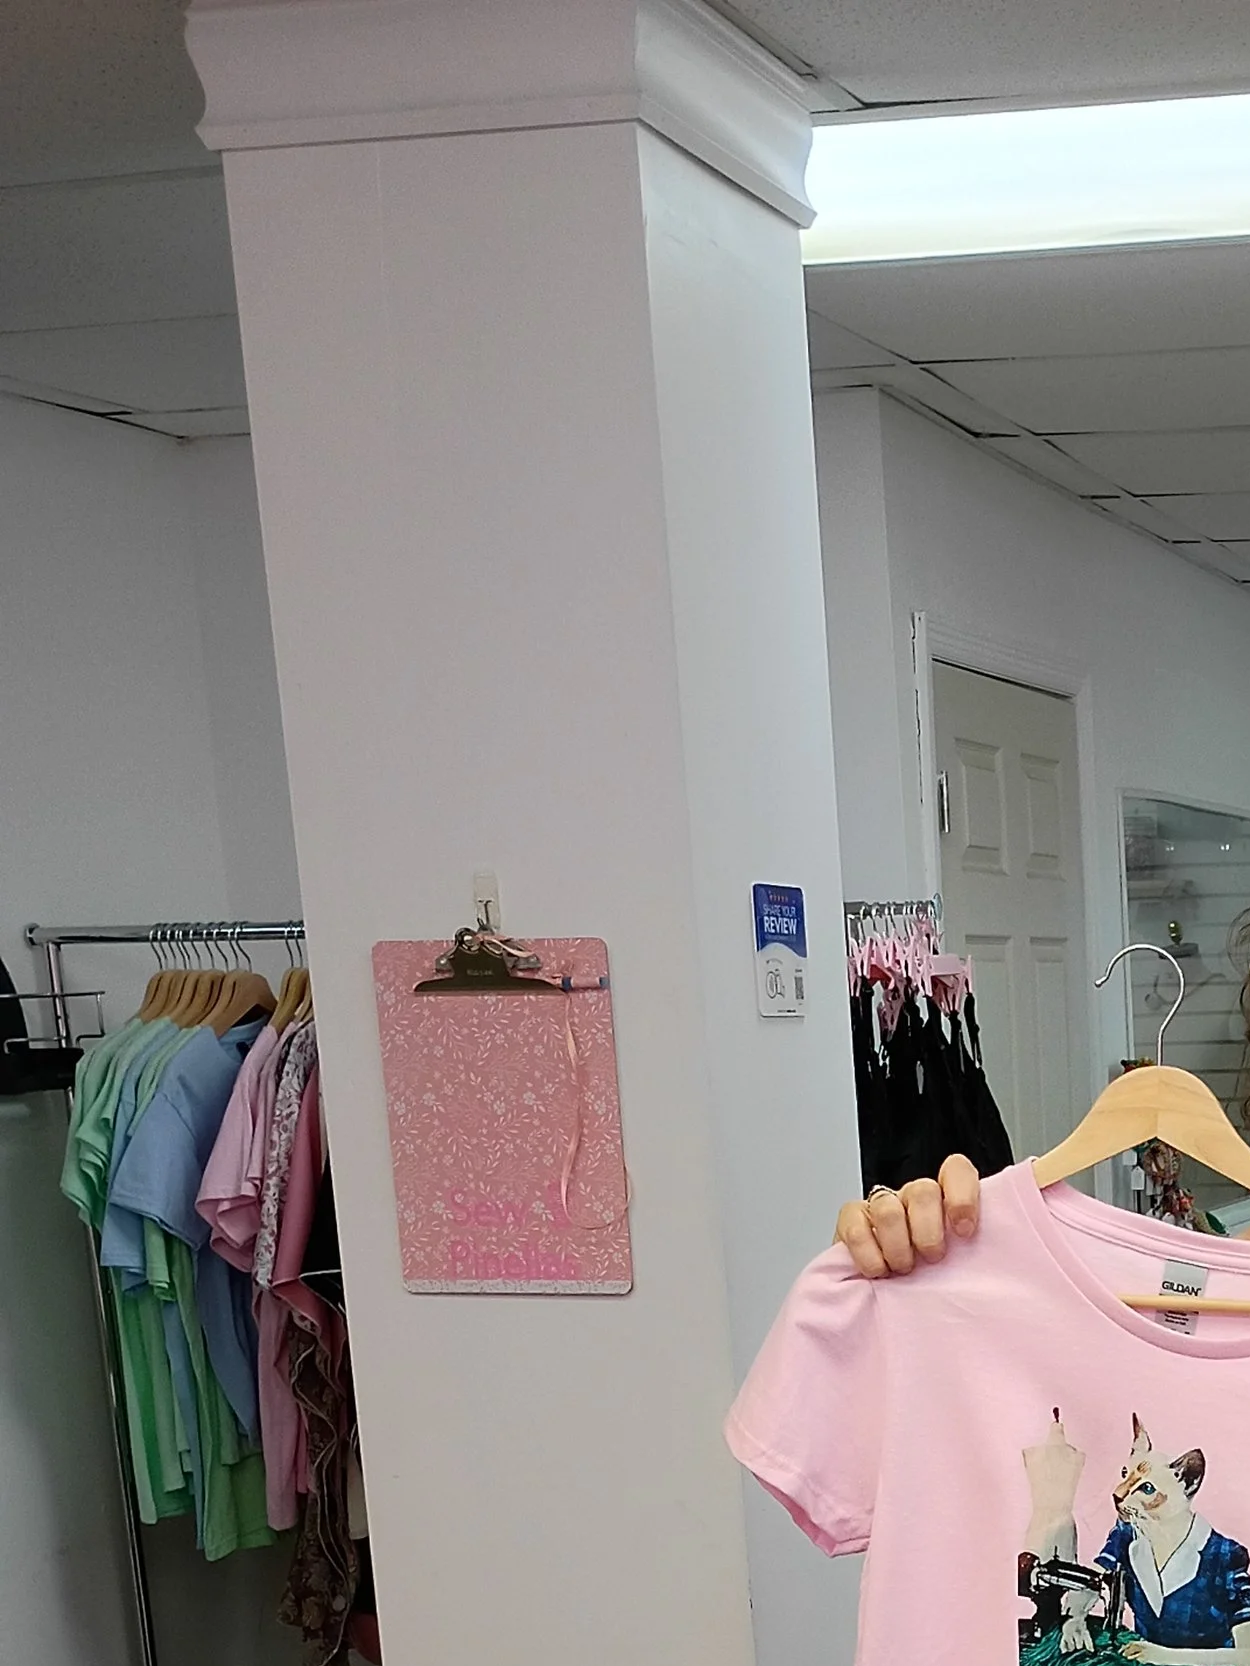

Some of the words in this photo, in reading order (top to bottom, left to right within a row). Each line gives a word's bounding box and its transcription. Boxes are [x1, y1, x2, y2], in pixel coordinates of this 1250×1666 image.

[763, 903, 781, 916] SHARE
[781, 905, 796, 917] YOUR
[763, 915, 797, 935] REVIEW
[1162, 1281, 1202, 1296] GILDAN
